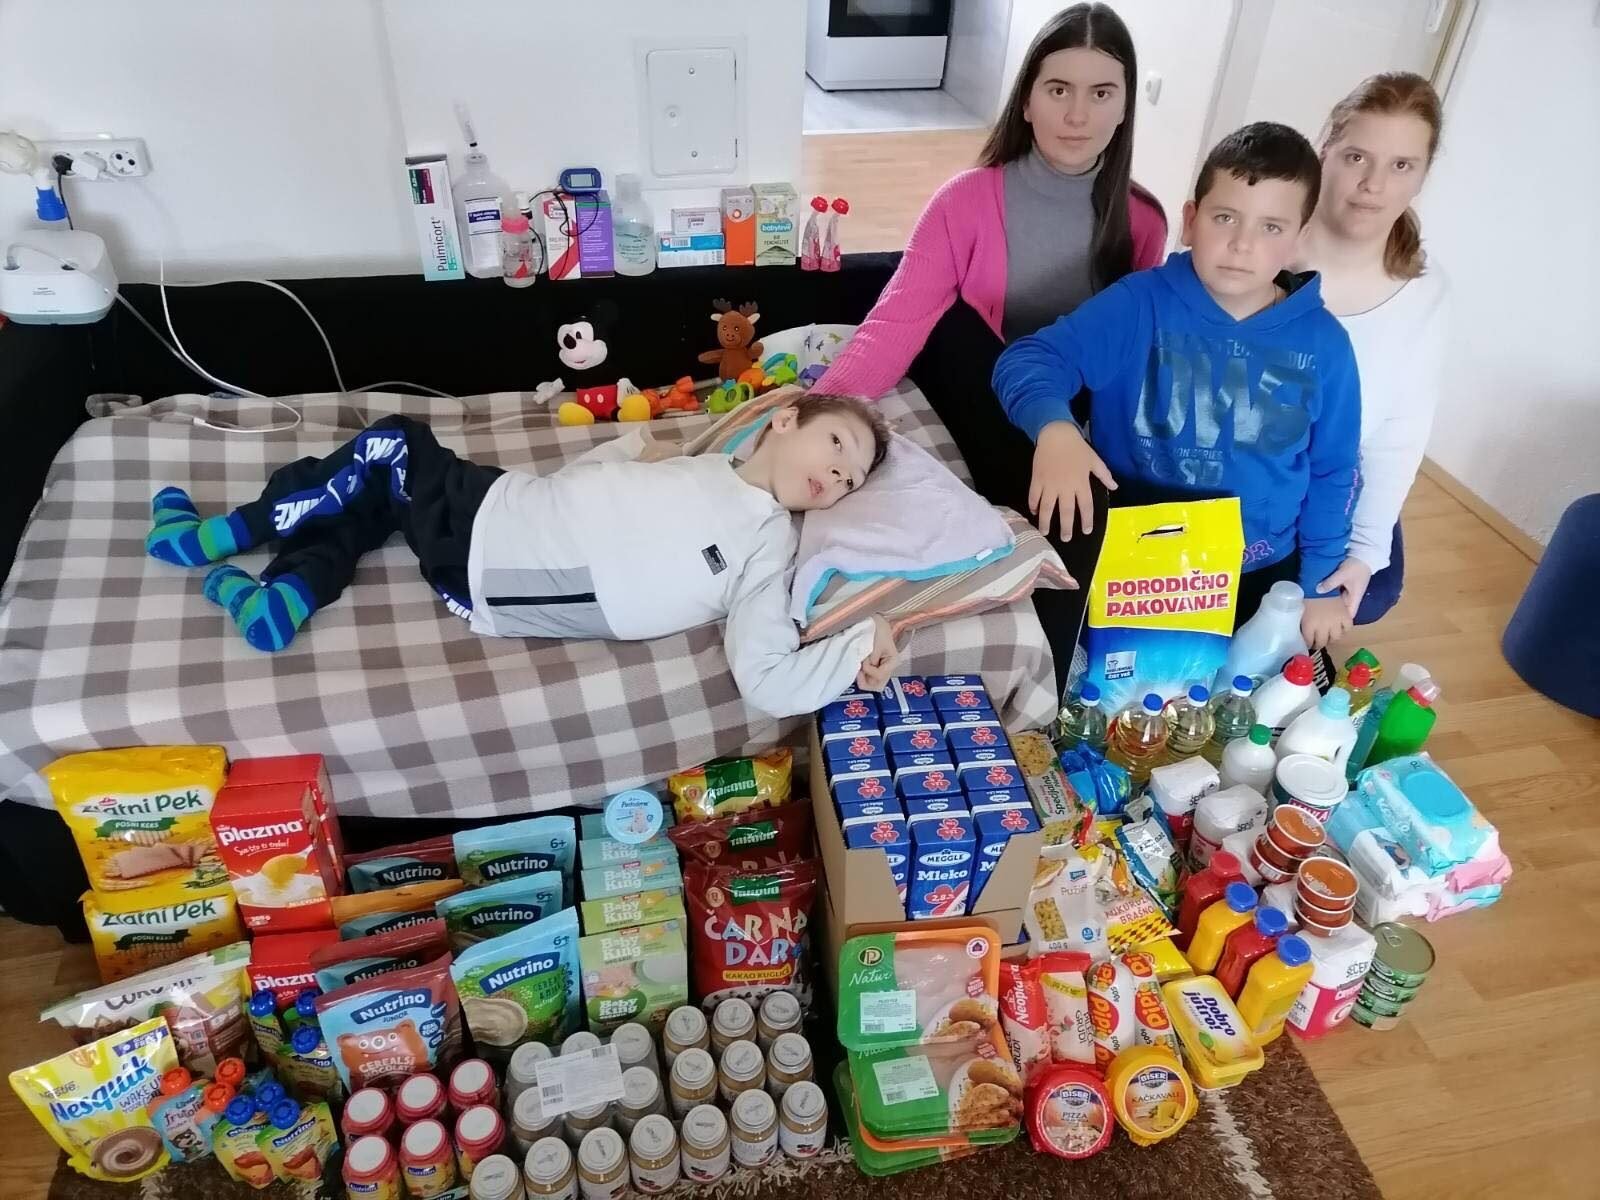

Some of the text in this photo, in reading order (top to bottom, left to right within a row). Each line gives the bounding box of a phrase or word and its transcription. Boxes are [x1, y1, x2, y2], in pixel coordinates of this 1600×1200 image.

[432, 219, 448, 272] Pulmicort
[1107, 570, 1229, 597] PORODIČNO
[1106, 593, 1229, 617] PAKOVANJE
[155, 790, 203, 813] Pek
[219, 819, 303, 847] plazma
[550, 838, 567, 849] 6+
[487, 857, 549, 877] Nutrino
[927, 854, 964, 863] MEGGLE
[383, 866, 442, 883] Nutrino
[917, 869, 968, 881] Mleko
[605, 879, 641, 891] King
[173, 900, 217, 921] Pek
[472, 908, 534, 925] Nutrino
[604, 911, 642, 923] King
[255, 973, 316, 991] plazm
[488, 958, 554, 990] Nutrino
[725, 971, 756, 980] KAKAO
[359, 993, 426, 1021] Nutrino
[383, 1010, 409, 1023] JUNIOR
[1182, 991, 1223, 1030] jutro!
[1203, 997, 1236, 1036] Dobro
[1075, 1009, 1086, 1044] GRUDI
[1140, 1072, 1167, 1082] BISER
[50, 1055, 155, 1121] Nesquik
[119, 1086, 149, 1108] WAKE
[1062, 1090, 1089, 1099] BISER
[1062, 1111, 1088, 1119] PIZZA
